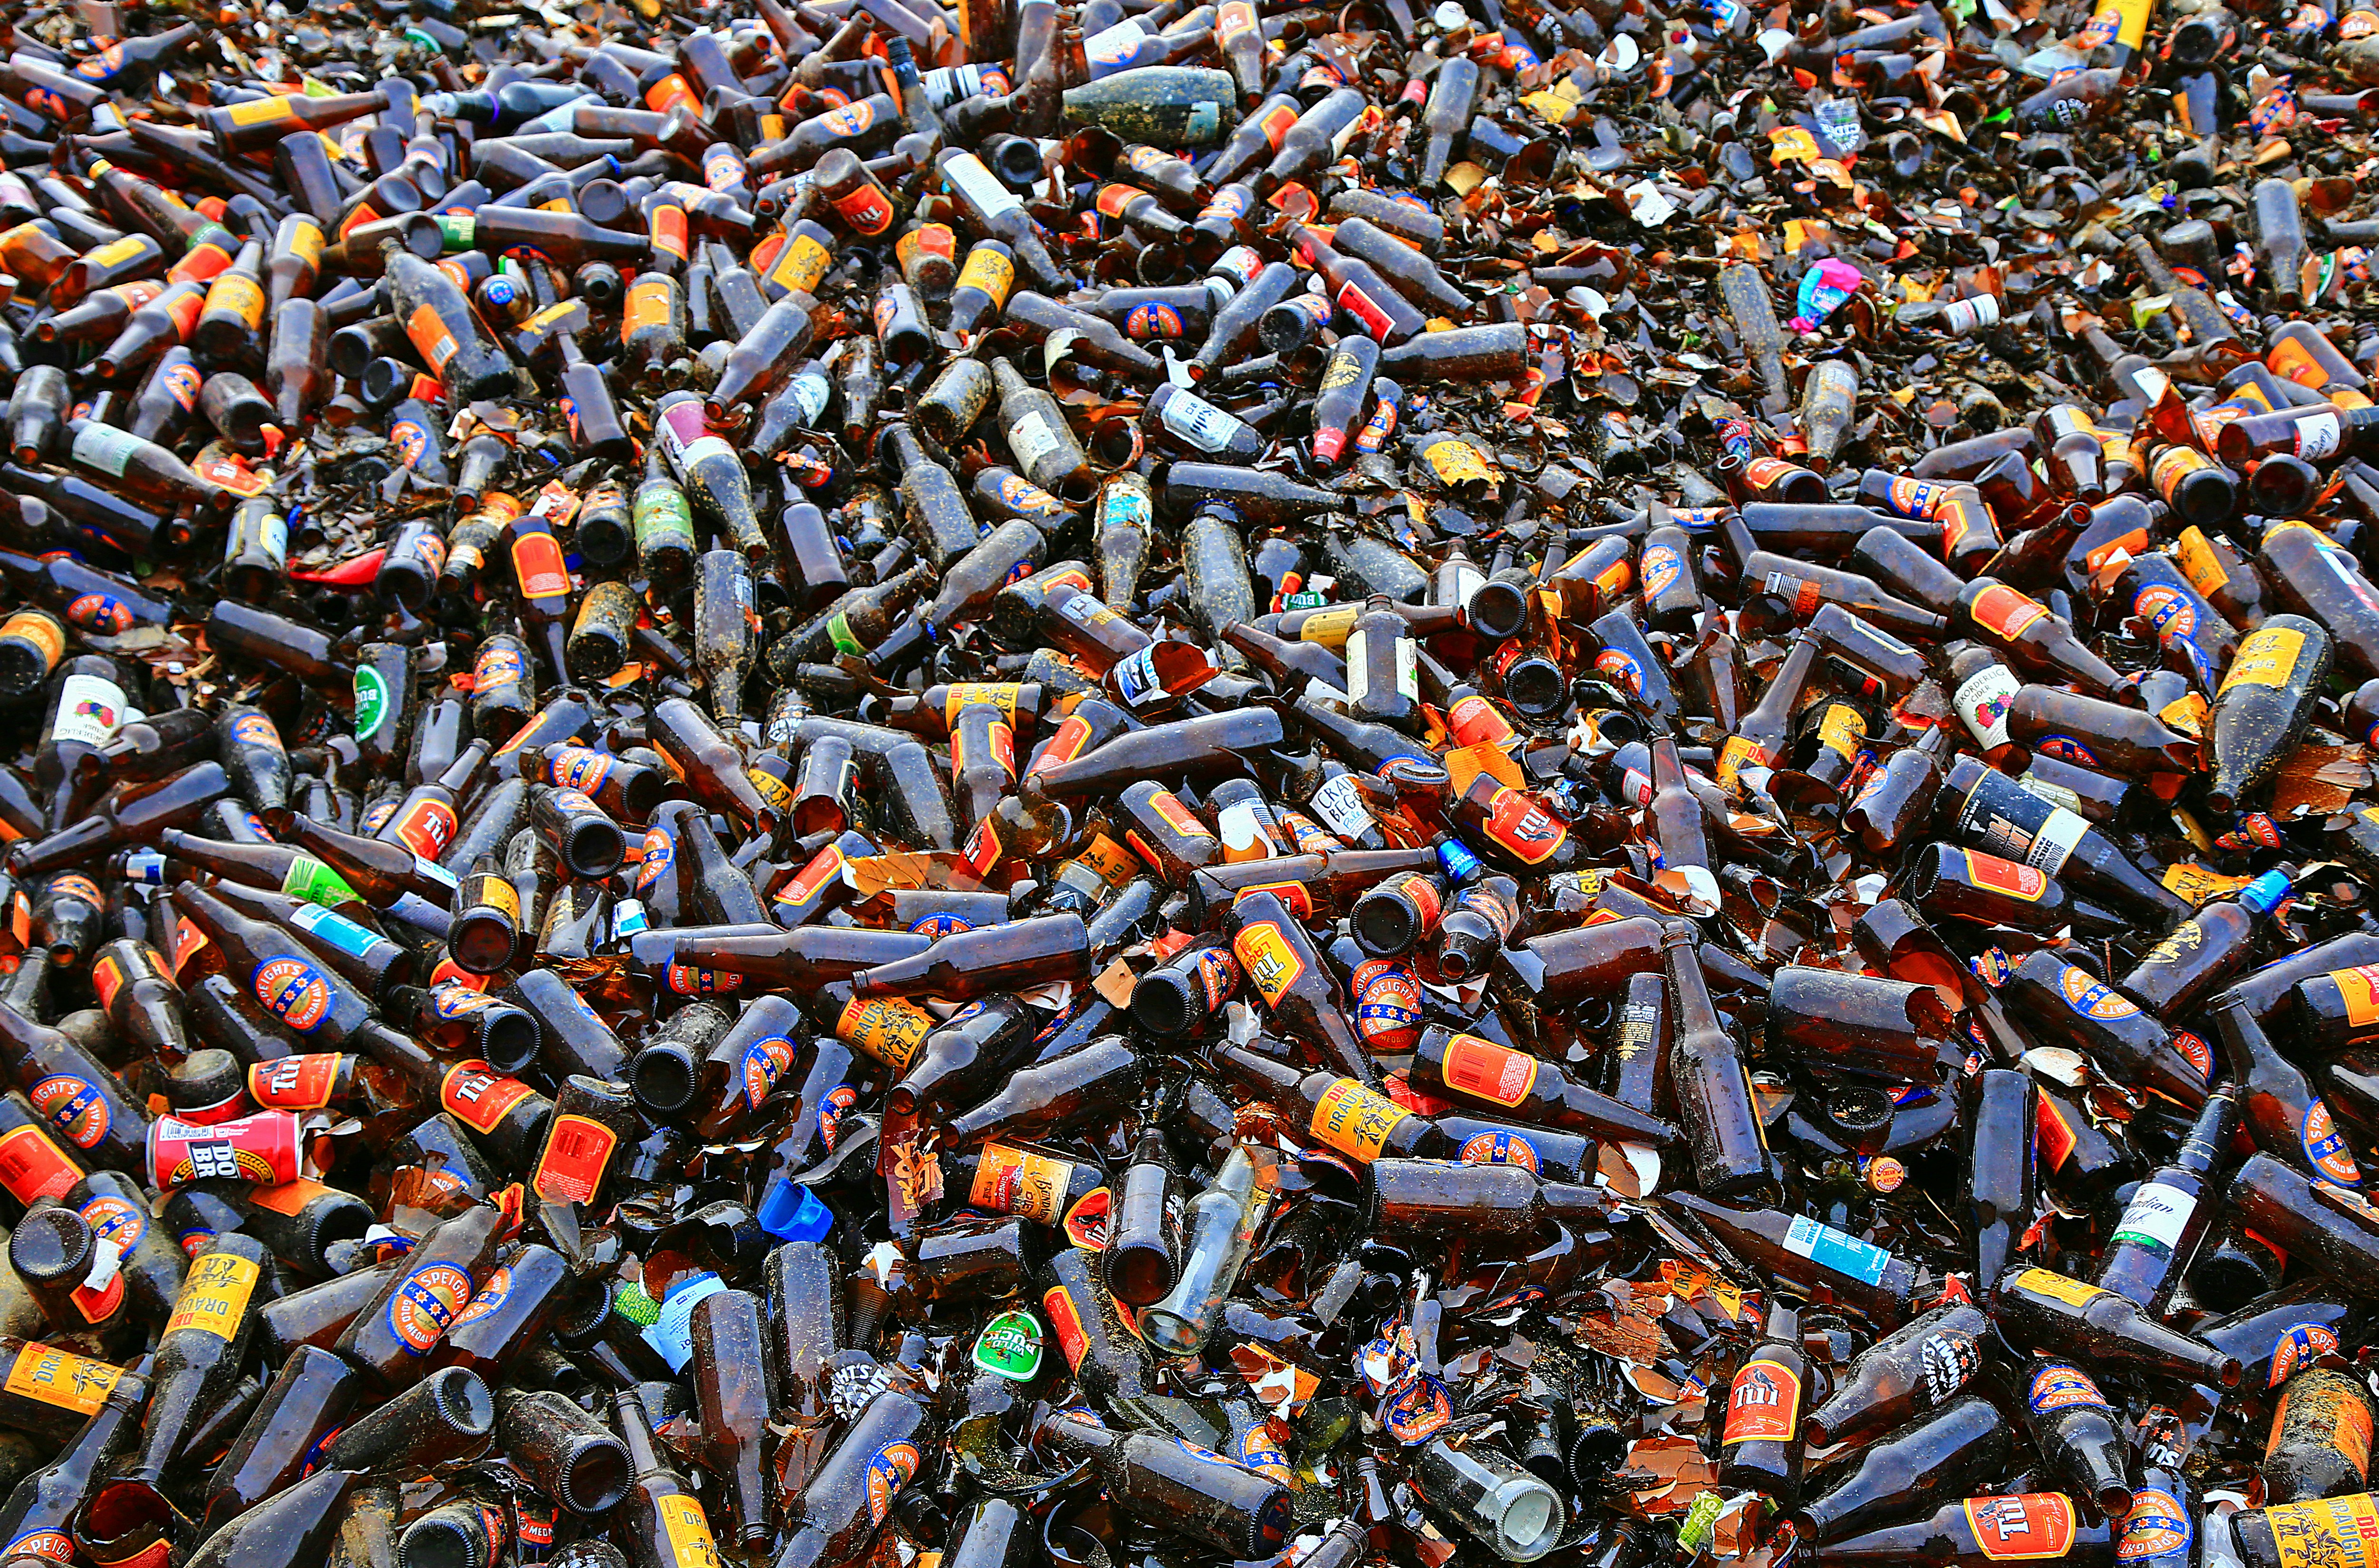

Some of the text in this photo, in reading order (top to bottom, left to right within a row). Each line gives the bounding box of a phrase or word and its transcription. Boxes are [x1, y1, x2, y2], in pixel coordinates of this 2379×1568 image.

[850, 205, 883, 223] Tui
[1955, 667, 2005, 712] REKORDERLIG
[1971, 684, 1992, 702] CIDER
[1343, 809, 1364, 832] Pale
[1514, 809, 1550, 842] Tui
[263, 962, 302, 1006] SPEIGHT'S
[1367, 981, 1419, 1011] SPEIGHT'S
[846, 1000, 864, 1021] DB
[852, 997, 892, 1048] DRAUGH
[32, 1082, 77, 1106] EIGHT'S
[1326, 1086, 1347, 1102] DB
[420, 1271, 472, 1319] SPEIGHT'S
[174, 1313, 194, 1327] DB
[1734, 1382, 1779, 1409] Tui
[2000, 1497, 2031, 1541] Tui
[2356, 1515, 2379, 1541] DB
